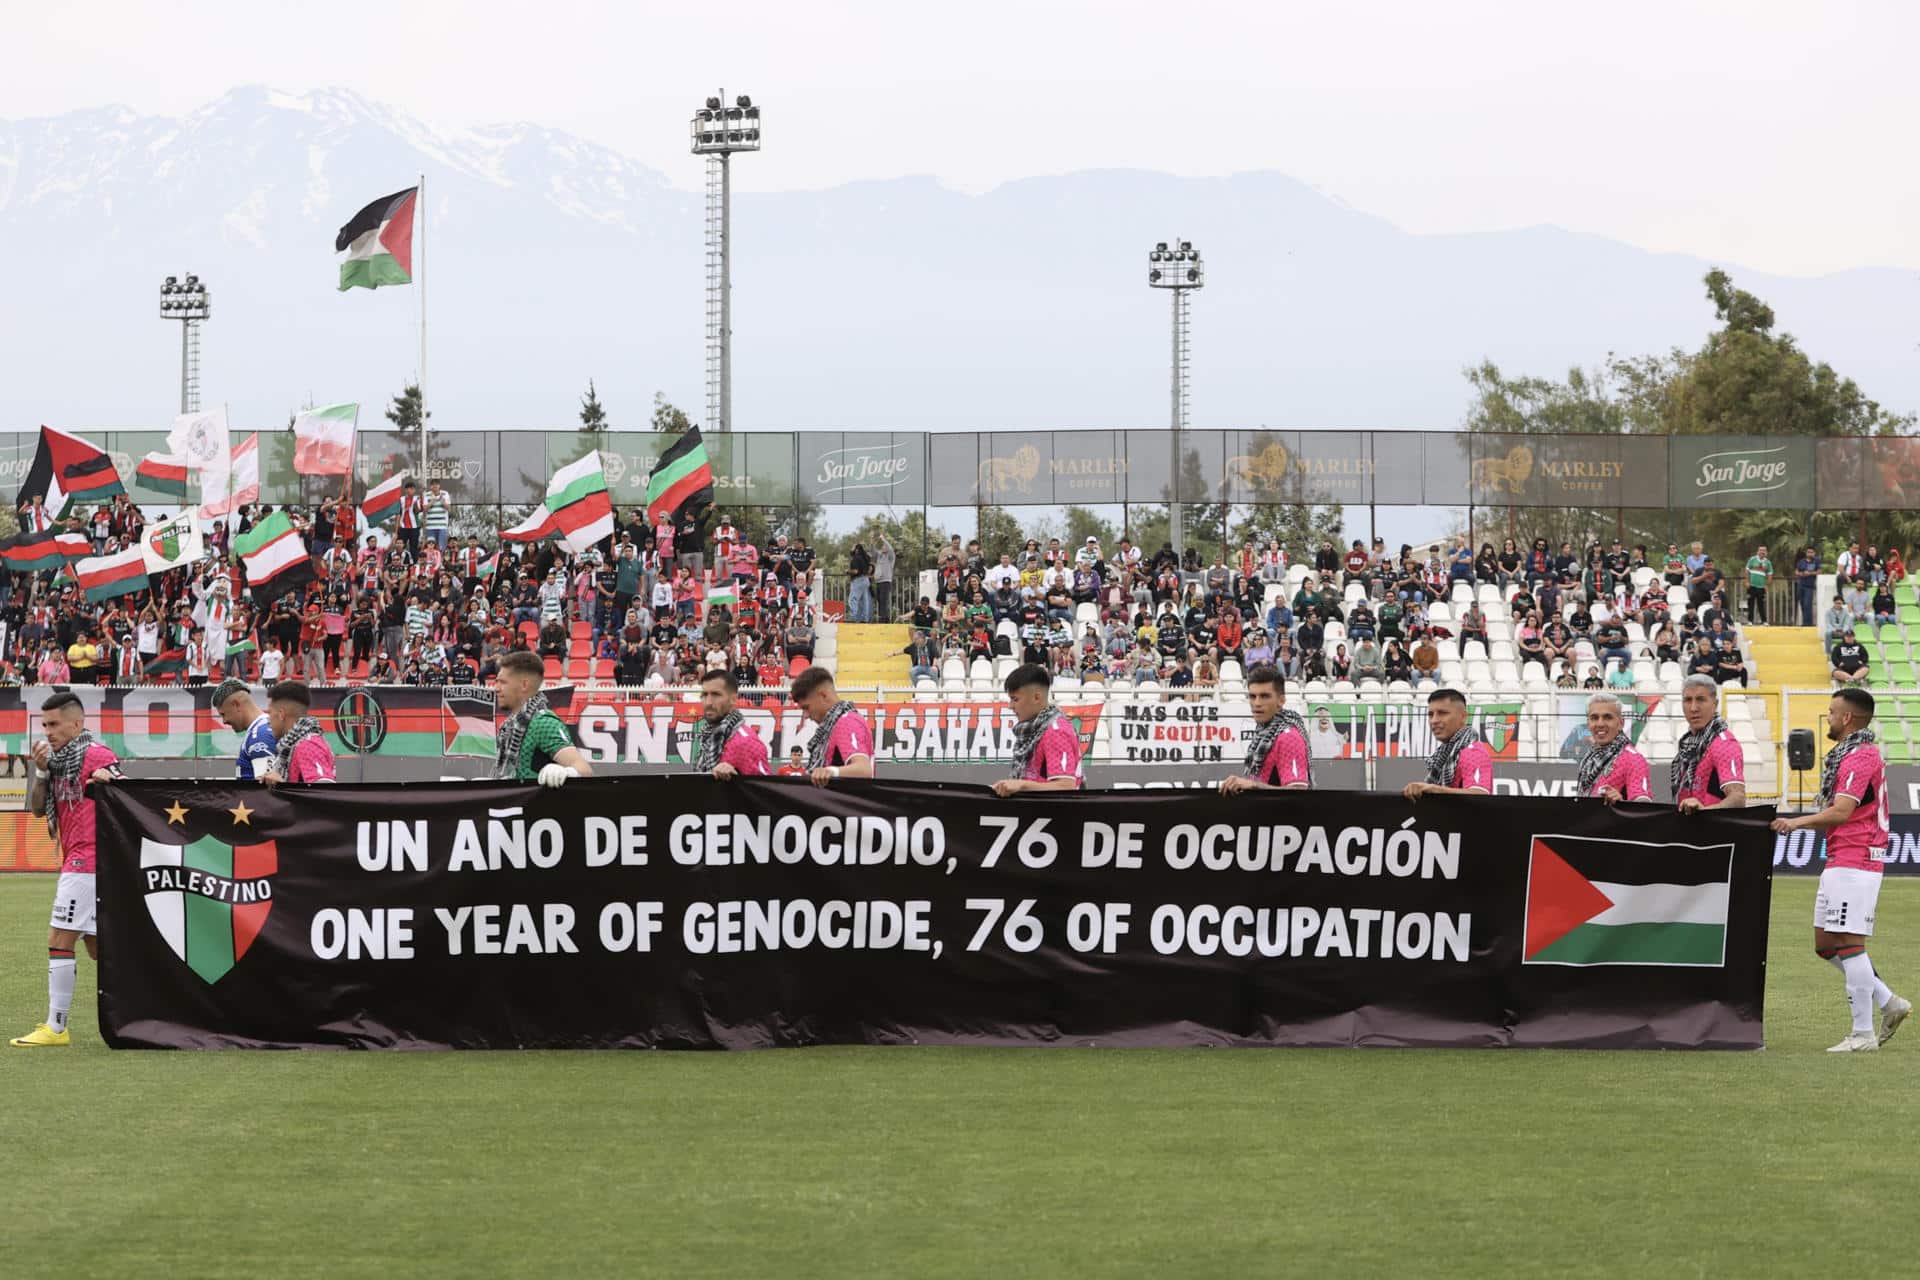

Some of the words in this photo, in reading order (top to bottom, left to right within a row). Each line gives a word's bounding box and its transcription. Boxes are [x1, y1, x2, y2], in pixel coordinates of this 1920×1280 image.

[401, 468, 462, 480] PUEBLO
[817, 459, 855, 484] San
[855, 455, 908, 481] Jorge
[1048, 457, 1132, 475] MARLEY
[1296, 457, 1377, 475] MARLEY
[1541, 461, 1624, 477] MARLEY
[1696, 462, 1735, 487] San
[1734, 459, 1787, 485] Jorge
[1561, 481, 1604, 490] COFFEE
[445, 686, 494, 702] PALESTINO
[1176, 706, 1219, 722] QUE
[1120, 723, 1150, 740] UN
[1126, 746, 1183, 762] TODO
[1193, 745, 1222, 762] UN
[357, 820, 428, 872] UN
[448, 806, 564, 872] AÑO
[585, 815, 648, 867] DE
[669, 814, 957, 874] GENOCIDIO,
[979, 815, 1058, 869] 76
[1081, 821, 1145, 869] DE
[1165, 816, 1461, 879] OCUPACIÓN
[146, 869, 272, 903] PALESTINO
[311, 908, 415, 960] ONE
[434, 903, 579, 955] YEAR
[600, 901, 664, 952] OF
[683, 899, 943, 960] GENOCIDE,
[965, 898, 1044, 953] 76
[1066, 902, 1131, 953] OF
[1151, 903, 1471, 962] OCCUPATION
